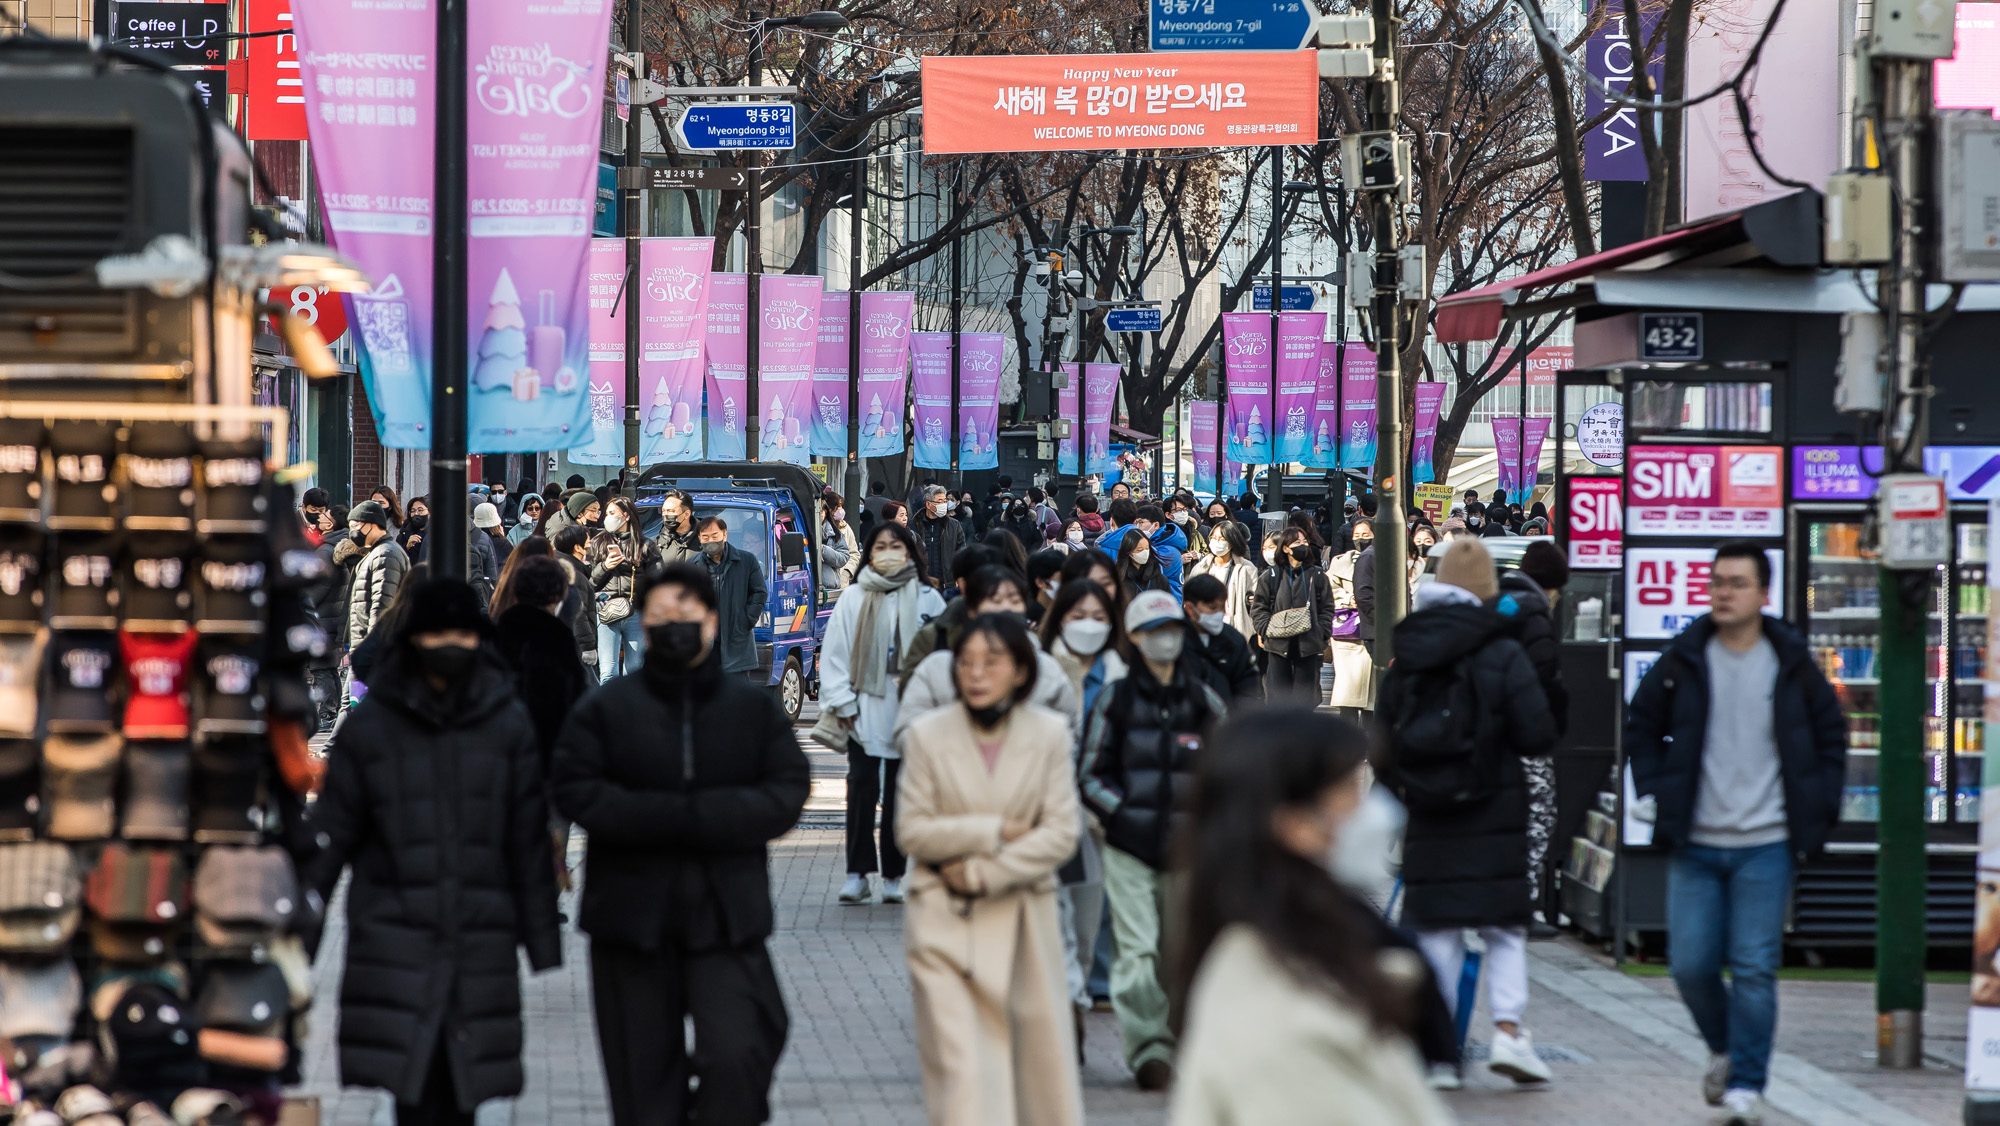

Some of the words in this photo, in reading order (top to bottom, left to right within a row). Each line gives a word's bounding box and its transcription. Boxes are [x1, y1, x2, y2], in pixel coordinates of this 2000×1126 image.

[1158, 0, 1215, 15] 명동7길
[1272, 3, 1277, 12] 1
[1287, 3, 1299, 13] 26
[128, 18, 177, 32] Coffee
[1158, 19, 1232, 33] Myeongdong
[1236, 19, 1262, 33] 7-gil
[206, 50, 220, 60] 9F
[1063, 68, 1110, 83] Happy
[1113, 66, 1143, 79] New
[1146, 66, 1179, 78] Year
[993, 86, 1046, 116] 새해
[1054, 86, 1078, 116] 복
[1085, 84, 1137, 116] 많이
[1145, 82, 1247, 114] 받으세요
[746, 108, 791, 123] 명동8길
[707, 126, 767, 136] Myeongdong
[769, 126, 791, 136] 8-gil
[1033, 125, 1094, 141] WELCOME
[1096, 125, 1113, 139] TO
[1115, 124, 1167, 139] MYEONG
[1169, 123, 1205, 137] DONG
[1226, 123, 1299, 134] 명동관광특구협의회
[718, 139, 744, 147] 明洞8街
[746, 139, 791, 147] ミョンドン8ギル
[1254, 288, 1273, 296] 명동3
[1254, 297, 1288, 305] Myeonng
[1137, 311, 1159, 319] 명동4길
[1241, 331, 1262, 340] Korea
[1645, 327, 1697, 348] 43-2
[1228, 335, 1267, 356] Sale
[1582, 415, 1622, 429] 中一會
[1631, 460, 1711, 500] SIM
[1430, 486, 1453, 494] HELLO
[1430, 492, 1452, 500] Massage
[1636, 560, 1713, 606] 상품
